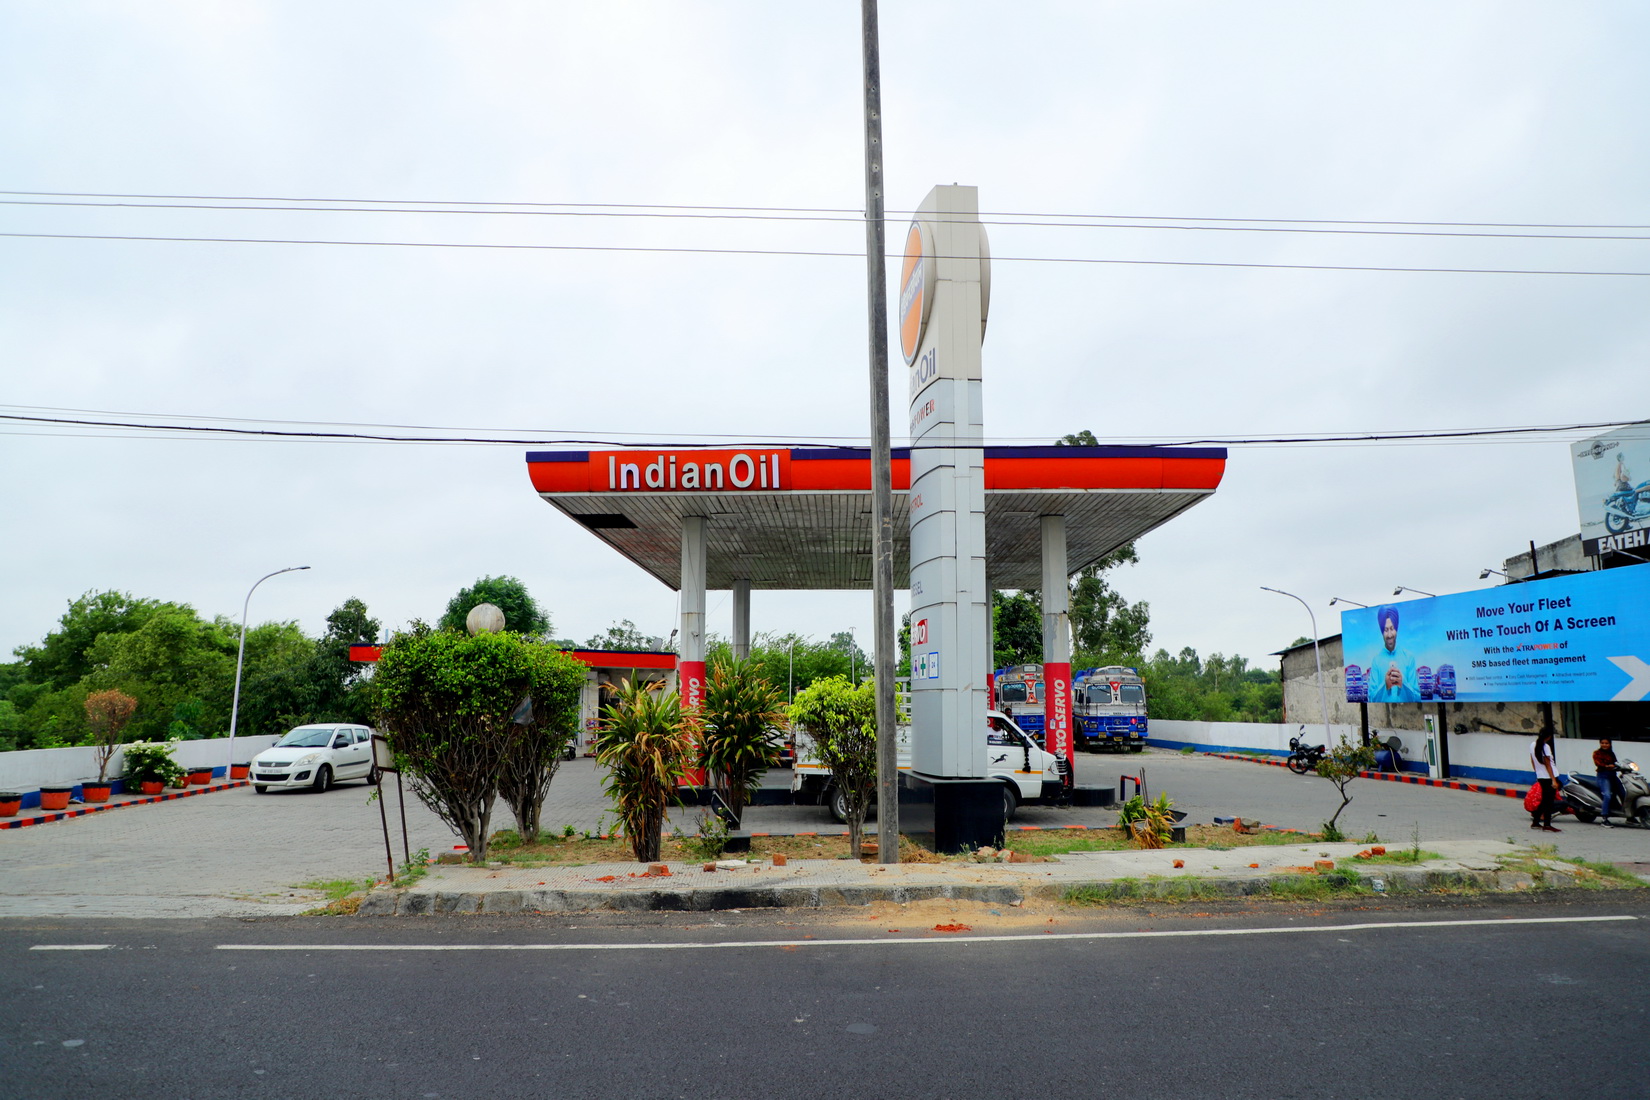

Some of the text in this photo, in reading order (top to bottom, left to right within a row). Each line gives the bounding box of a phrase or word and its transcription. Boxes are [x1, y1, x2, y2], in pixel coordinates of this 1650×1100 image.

[608, 453, 780, 489] IndianOil
[1476, 596, 1571, 618] Move Your Fleet
[1446, 615, 1616, 641] With The Touch Of A Screen
[1483, 645, 1501, 654] With
[1502, 645, 1514, 653] the
[1559, 640, 1568, 649] of
[1471, 654, 1586, 668] SMS based fleet management
[1054, 679, 1067, 722] SERVO
